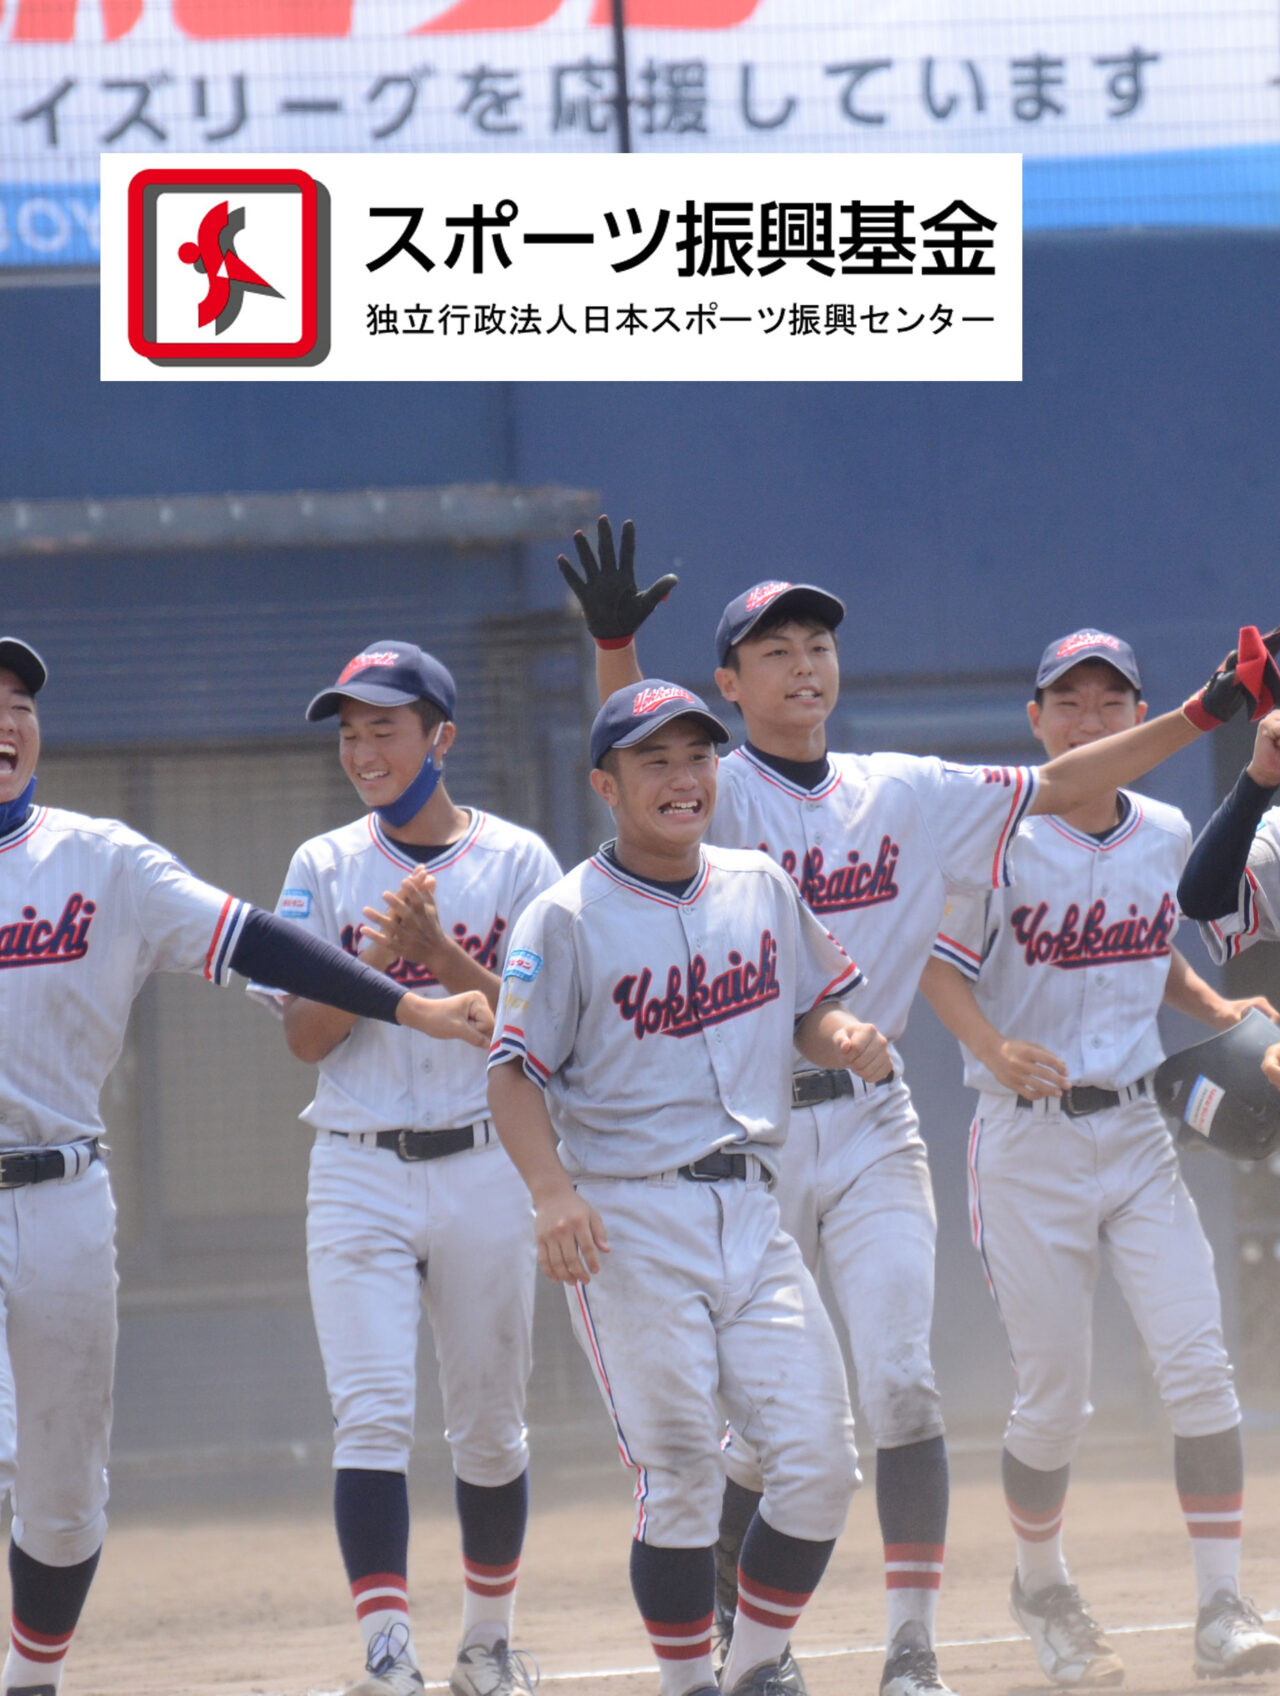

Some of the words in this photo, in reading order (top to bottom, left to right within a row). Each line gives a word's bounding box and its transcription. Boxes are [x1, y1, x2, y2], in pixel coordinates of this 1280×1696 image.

[742, 834, 899, 915] kkaichi
[1011, 891, 1176, 970] Yokkaichi
[613, 929, 780, 1040] Yokkaichi
